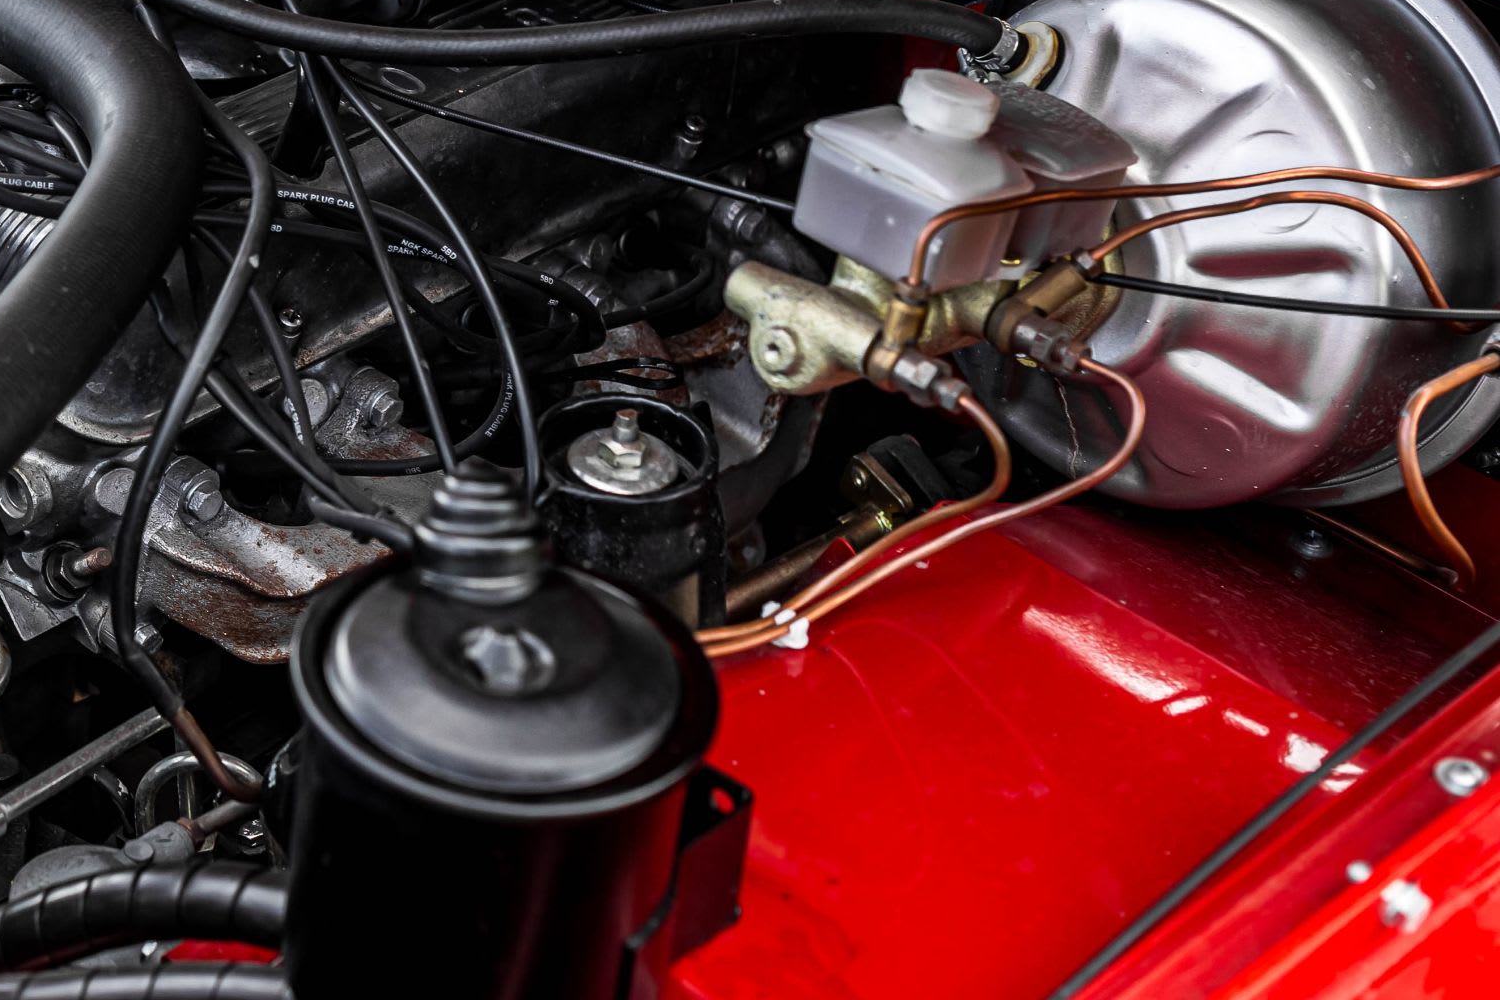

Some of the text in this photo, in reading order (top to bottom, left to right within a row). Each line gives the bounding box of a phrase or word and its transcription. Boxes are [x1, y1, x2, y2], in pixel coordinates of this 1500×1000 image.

[24, 179, 55, 190] CABLE
[277, 190, 356, 210] SPARK PLUG CAB
[400, 239, 422, 251] NGK
[440, 245, 458, 260] 5BD
[540, 274, 554, 285] 5BD
[500, 391, 513, 414] PLUG
[484, 414, 505, 438] CABLE
